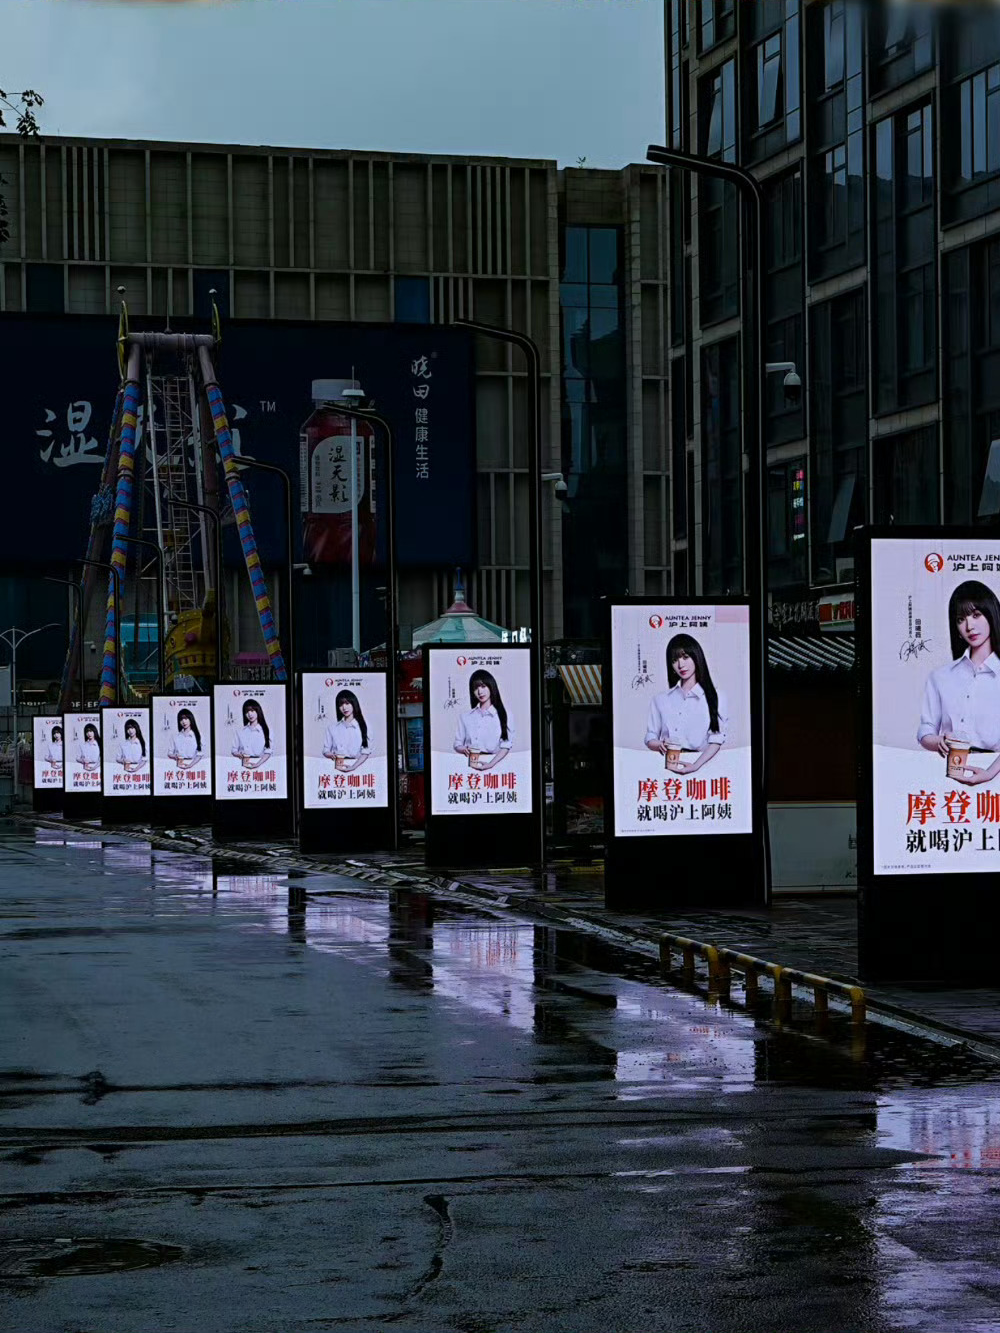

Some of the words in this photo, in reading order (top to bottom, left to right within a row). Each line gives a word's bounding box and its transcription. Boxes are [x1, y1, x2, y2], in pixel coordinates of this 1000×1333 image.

[414, 408, 430, 479] 健康生活
[328, 445, 349, 503] 湿天影
[947, 554, 982, 562] AUNTEA
[318, 773, 376, 789] 摩登咖啡
[448, 772, 517, 790] 摩登咖啡
[637, 777, 731, 802] 摩登咖啡
[318, 789, 376, 799] 就喝沪上阿姨
[448, 791, 517, 804] 就喝沪上阿姨
[637, 803, 732, 821] 就喝沪上阿姨
